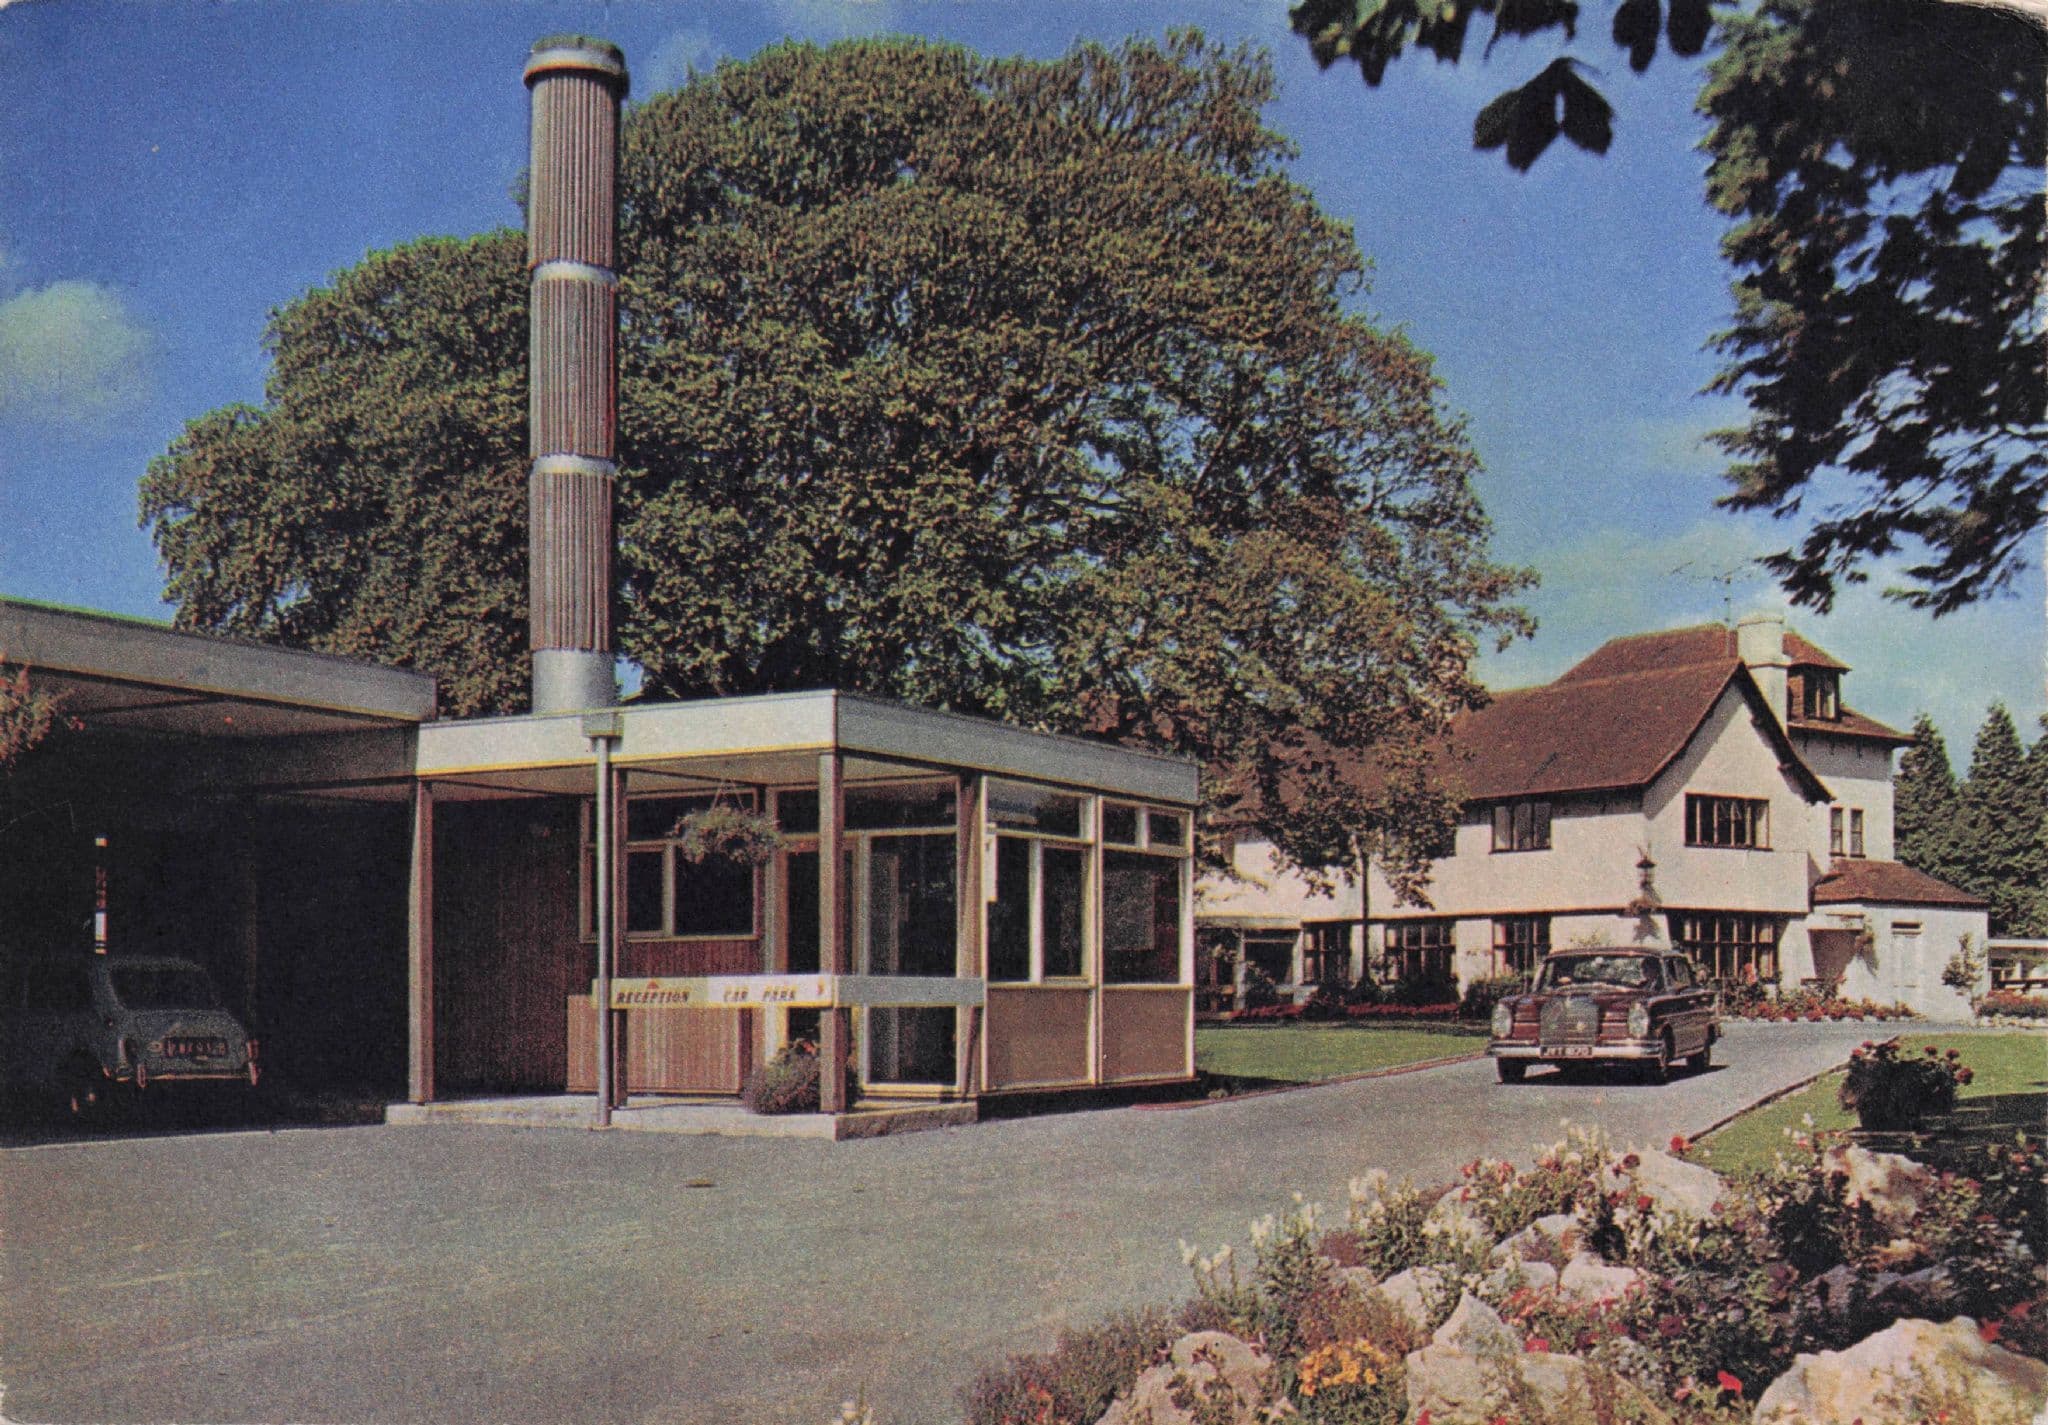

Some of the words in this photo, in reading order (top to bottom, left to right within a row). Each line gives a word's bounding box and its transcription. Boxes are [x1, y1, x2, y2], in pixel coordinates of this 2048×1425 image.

[616, 991, 689, 1003] RECEPTION
[723, 988, 748, 1002] CAR
[761, 987, 797, 1002] PARK
